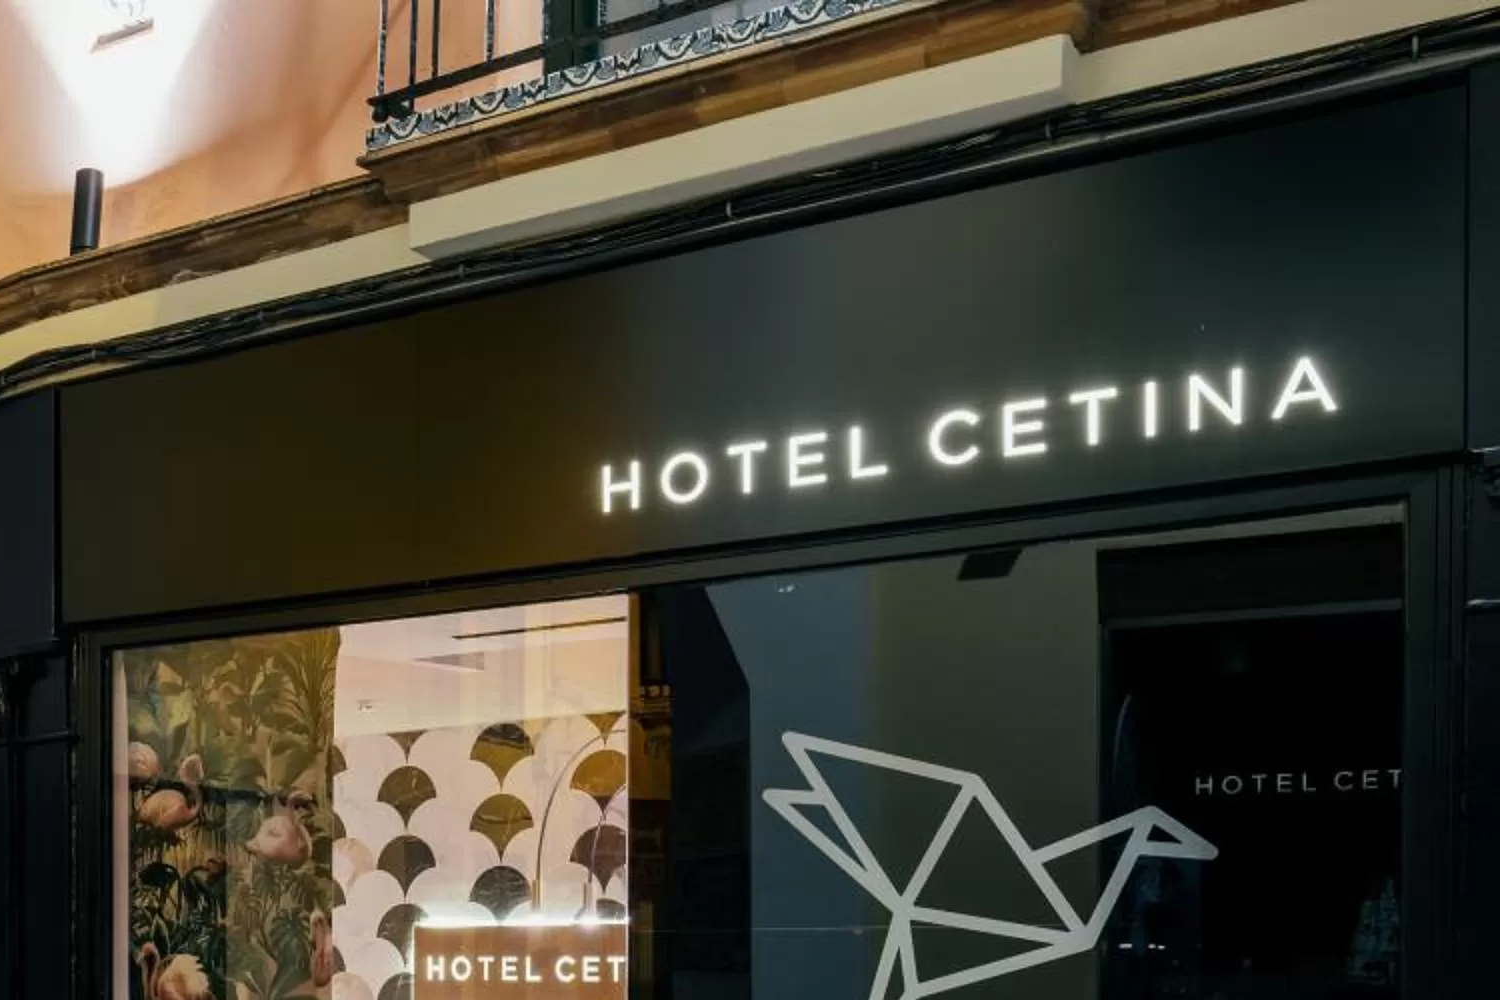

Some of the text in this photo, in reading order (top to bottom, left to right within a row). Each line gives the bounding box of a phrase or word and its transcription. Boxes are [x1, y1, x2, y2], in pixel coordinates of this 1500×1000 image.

[599, 354, 1340, 515] HOTEL CETINA
[1195, 768, 1403, 796] HOTEL CET
[426, 955, 626, 983] HOTEL CET
